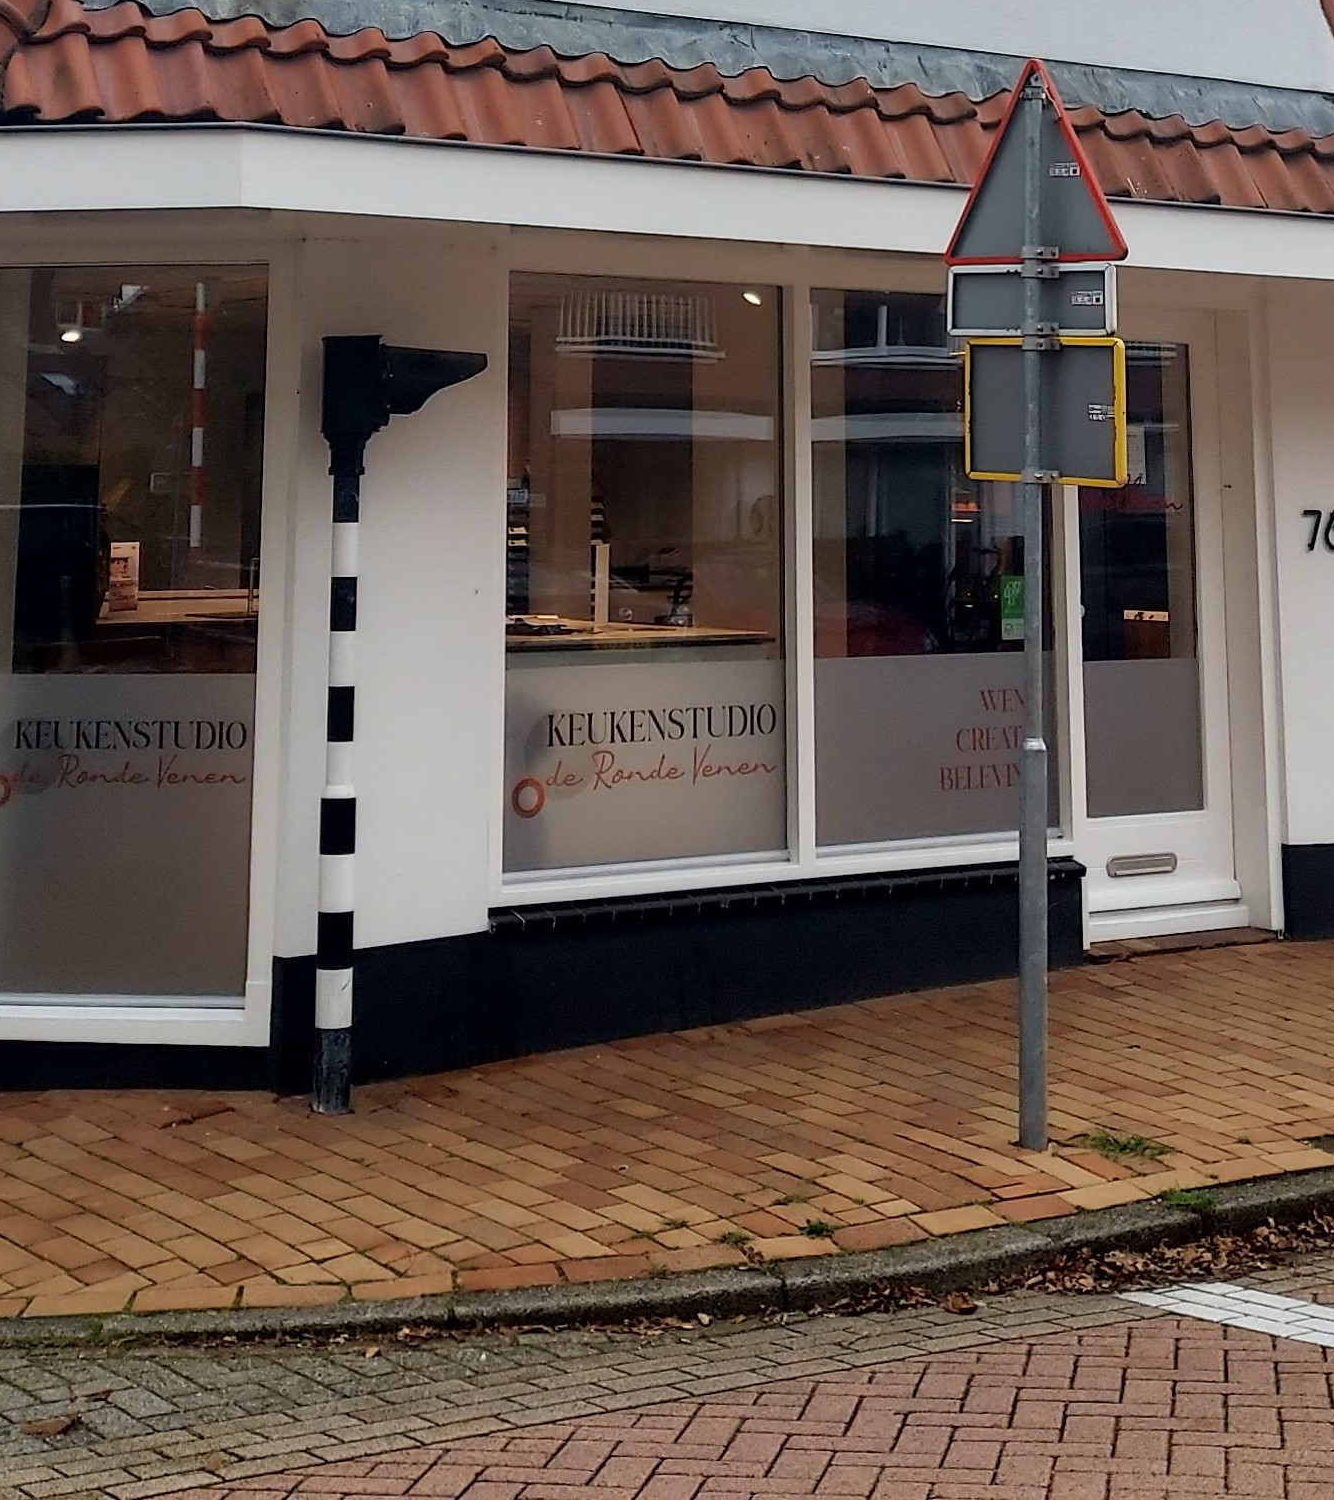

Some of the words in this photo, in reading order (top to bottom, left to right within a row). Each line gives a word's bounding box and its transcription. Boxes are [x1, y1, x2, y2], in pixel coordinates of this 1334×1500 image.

[980, 688, 1025, 713] WEN
[14, 720, 248, 750] KEUKENSTUDIO
[547, 703, 777, 748] KEUKENSTUDIO
[956, 725, 1023, 752] CREAT
[57, 752, 150, 789] Ronde
[156, 754, 247, 789] Venen
[545, 761, 584, 787] de
[593, 750, 685, 791] Ronde
[692, 744, 777, 786] Venen
[940, 763, 1021, 791] BELEVIN
